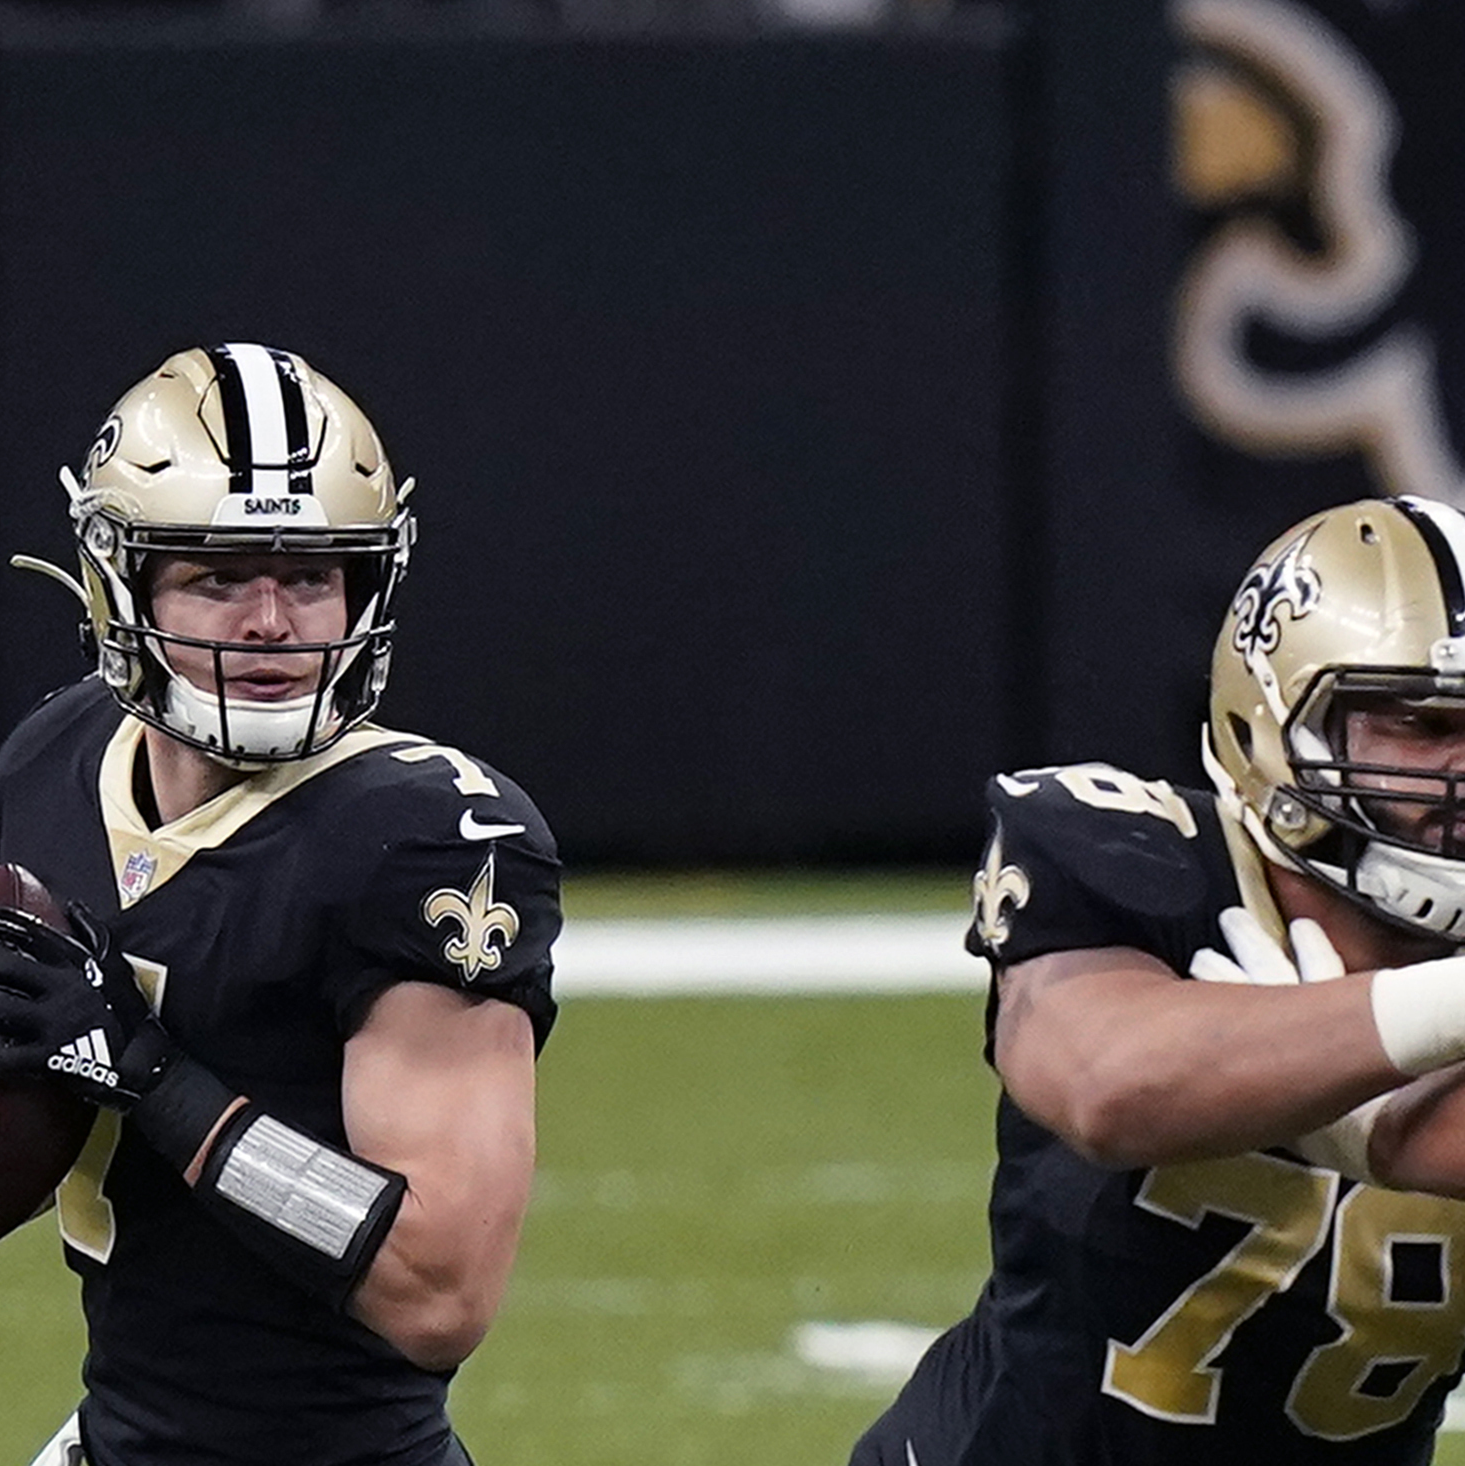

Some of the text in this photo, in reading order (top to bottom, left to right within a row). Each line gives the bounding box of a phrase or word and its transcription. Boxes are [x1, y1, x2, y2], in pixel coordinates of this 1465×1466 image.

[244, 497, 301, 515] SAINTS
[390, 744, 500, 798] 7
[47, 1054, 120, 1088] adidas
